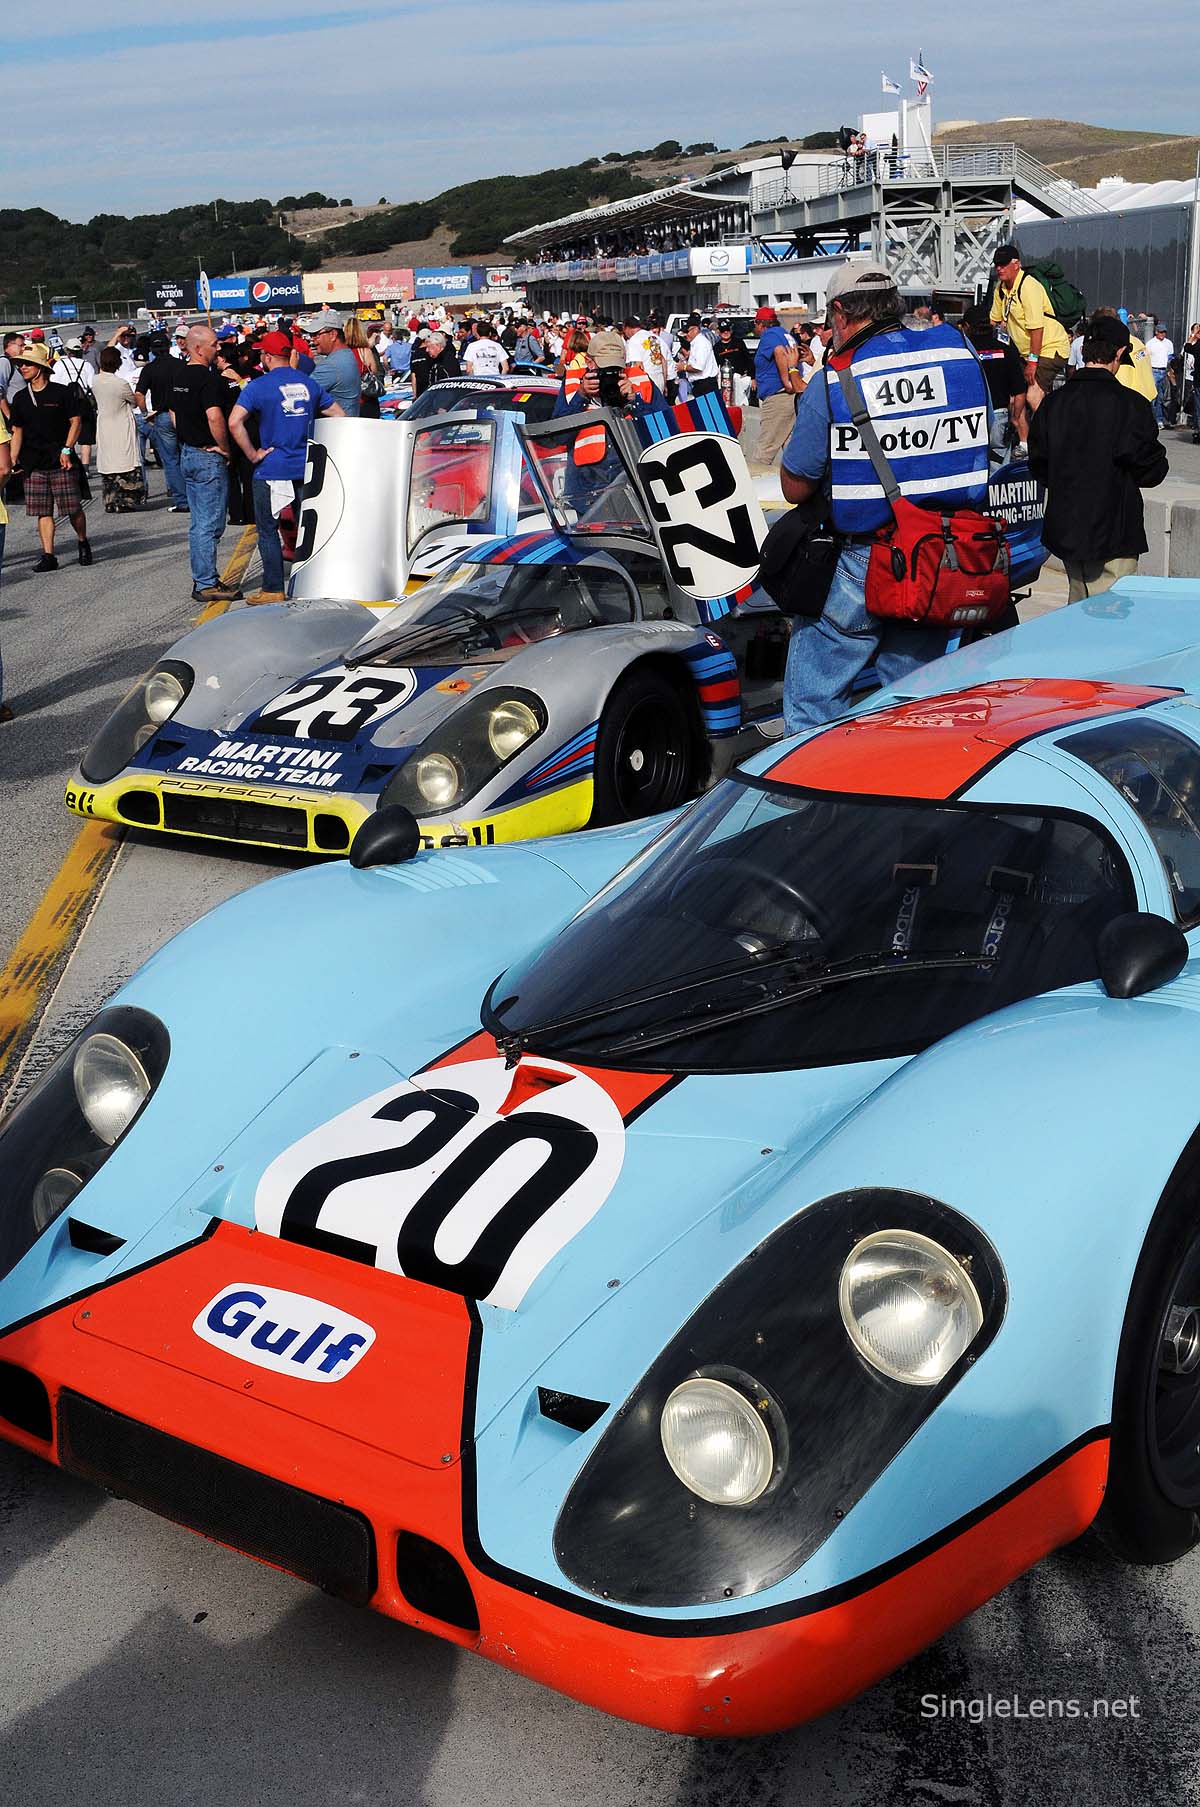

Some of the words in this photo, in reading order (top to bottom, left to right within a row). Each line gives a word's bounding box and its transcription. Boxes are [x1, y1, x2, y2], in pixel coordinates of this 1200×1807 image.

[271, 284, 300, 297] pepsi
[416, 275, 469, 286] COOPER
[875, 374, 936, 406] 404
[835, 412, 984, 452] Poto/TV
[988, 479, 1038, 507] MARTINI
[637, 437, 761, 587] 23
[248, 675, 407, 741] 23
[208, 740, 343, 770] MARTINI
[177, 756, 343, 787] RACING-TEAM
[279, 1088, 599, 1302] 20
[206, 1290, 367, 1374] Gulf
